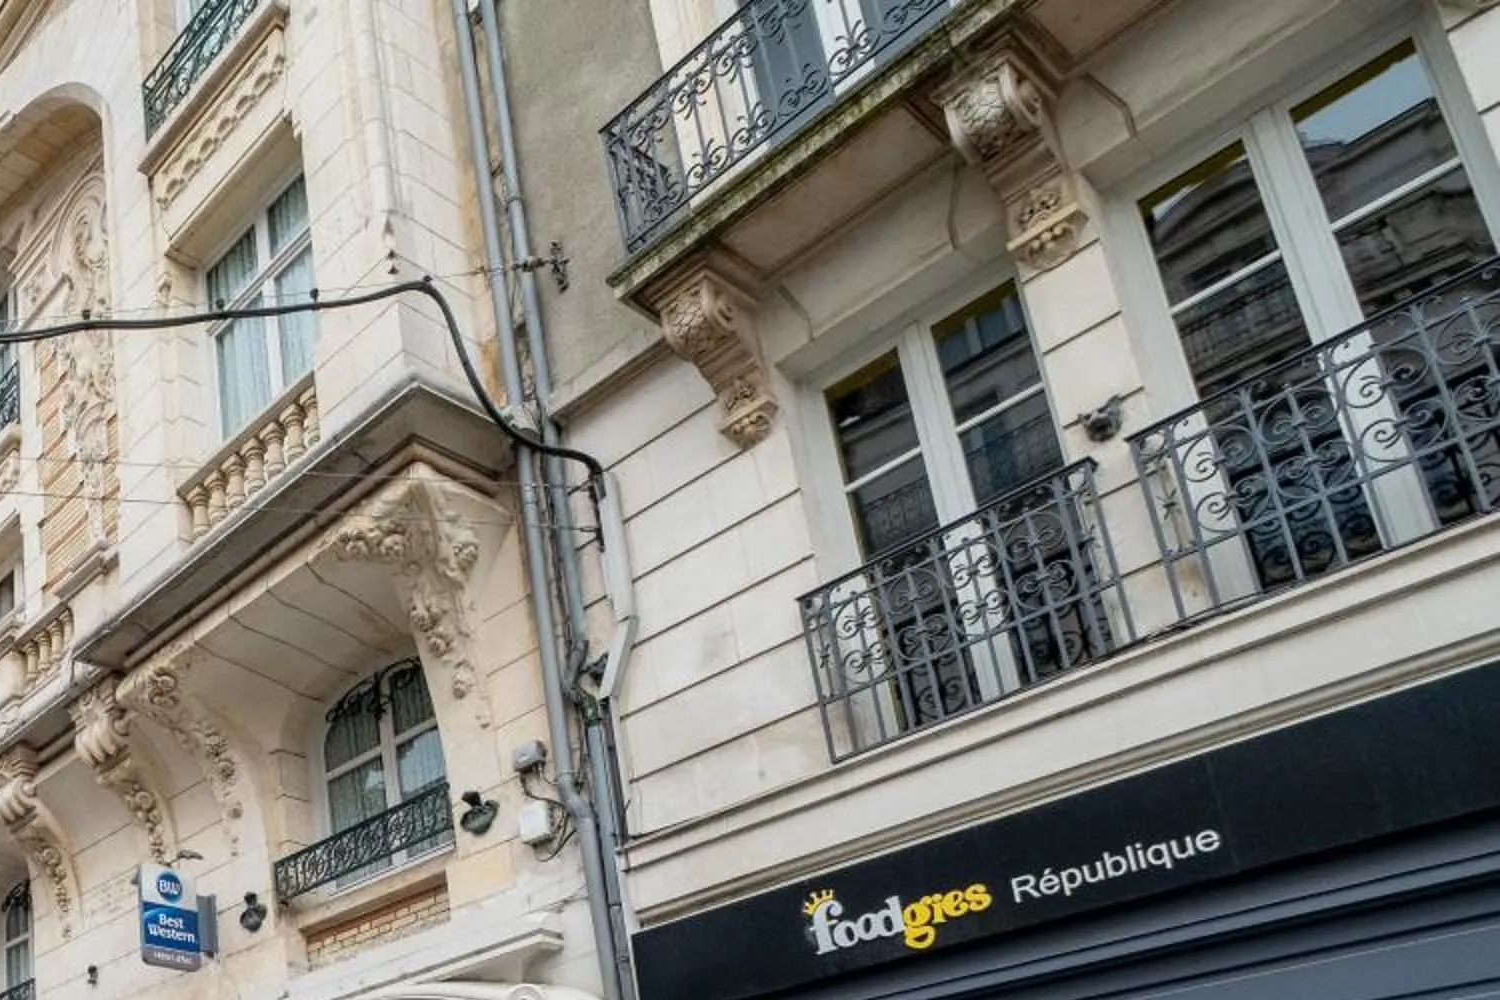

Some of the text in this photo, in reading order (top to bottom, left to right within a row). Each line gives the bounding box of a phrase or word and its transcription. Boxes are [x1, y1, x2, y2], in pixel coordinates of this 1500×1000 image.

[810, 828, 1222, 956] foodgies République
[159, 913, 185, 930] Best
[148, 923, 196, 943] Western
